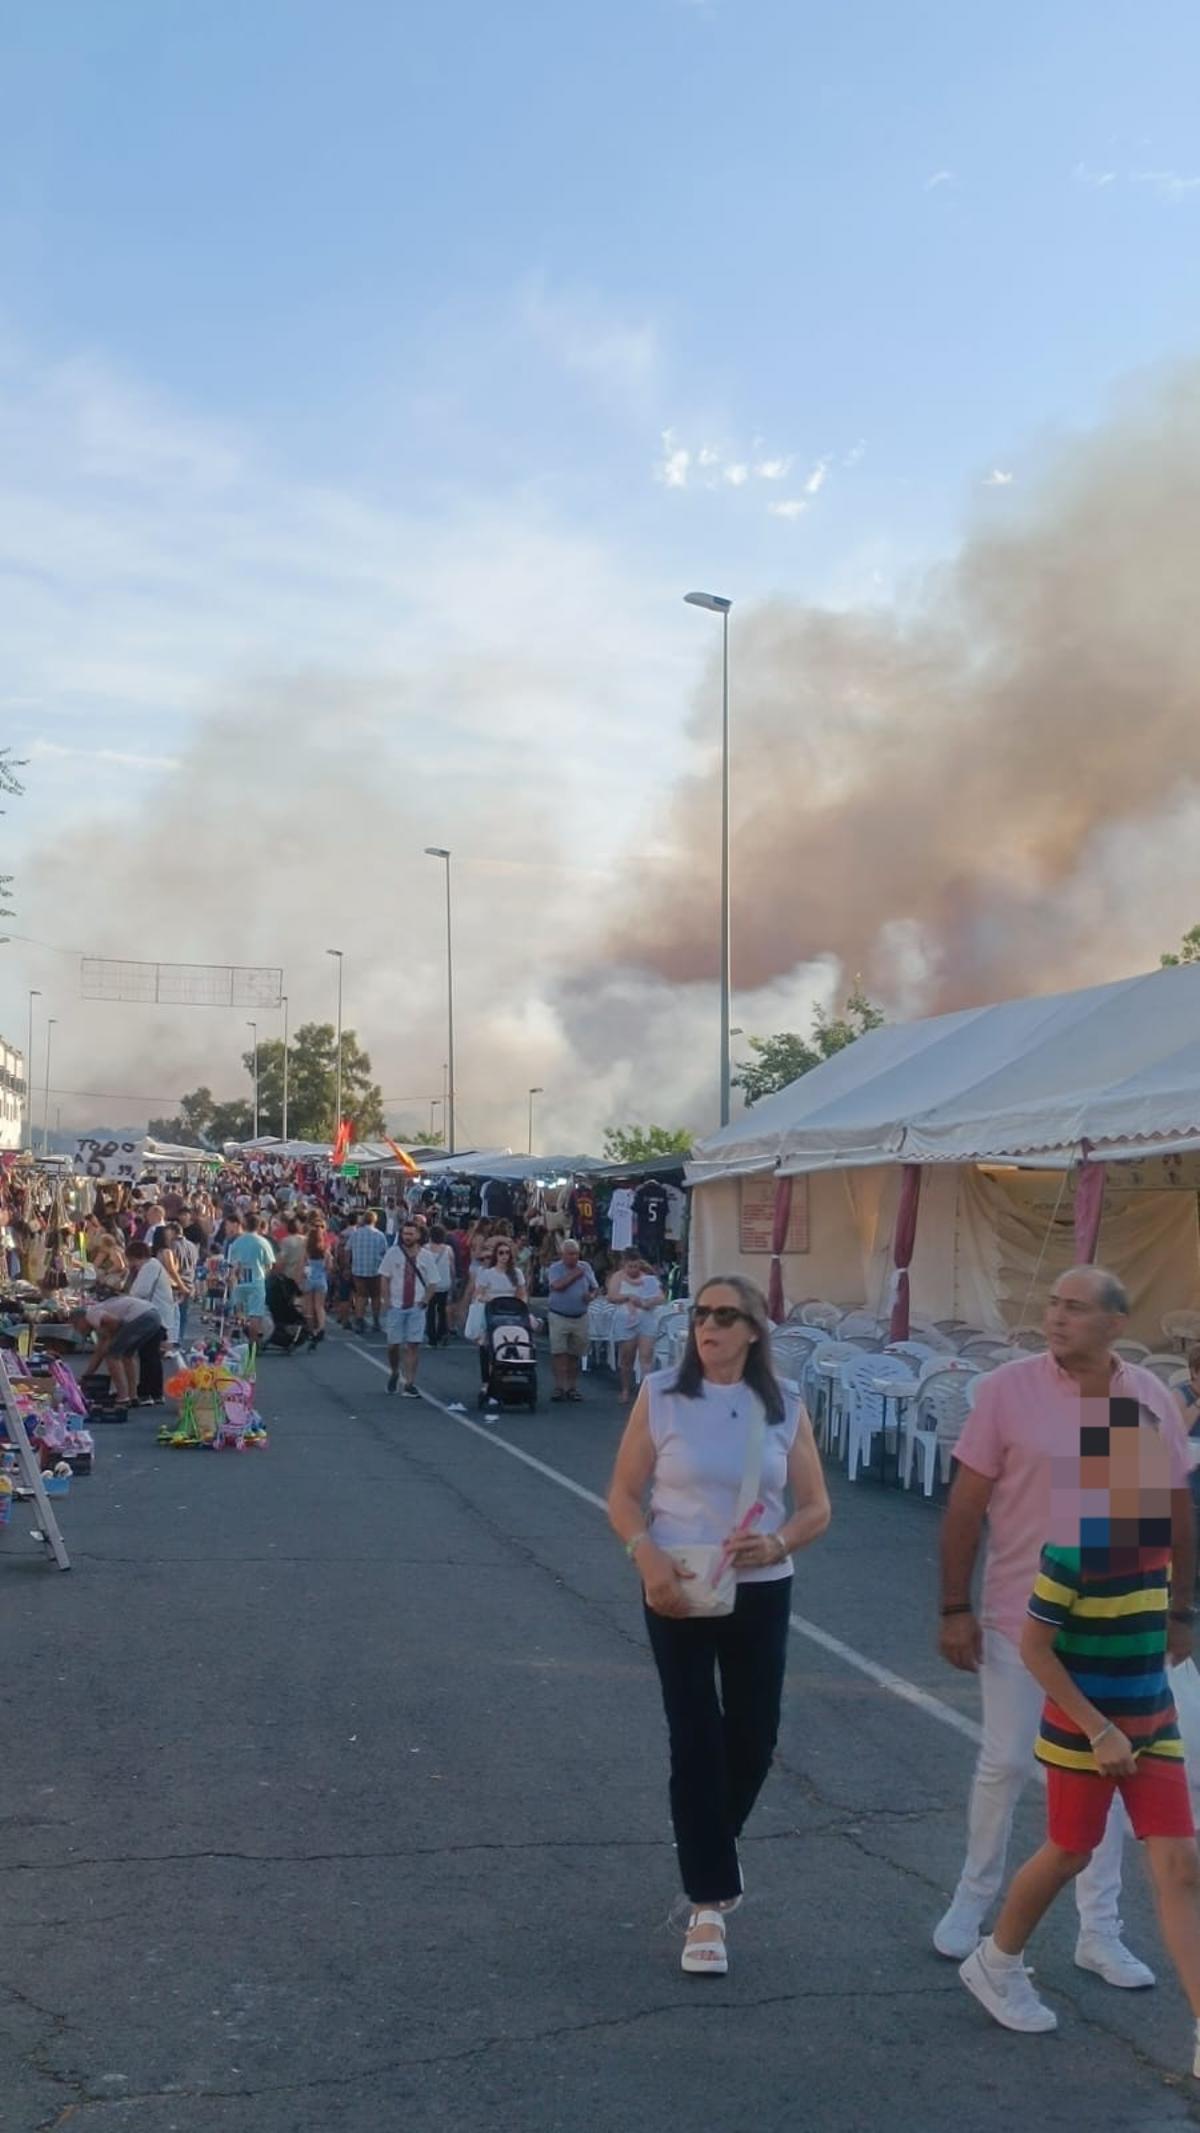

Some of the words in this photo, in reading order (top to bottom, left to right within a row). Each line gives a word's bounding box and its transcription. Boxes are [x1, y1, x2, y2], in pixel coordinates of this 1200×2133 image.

[77, 1139, 135, 1153] TODO
[578, 1201, 593, 1218] 10
[648, 1203, 659, 1222] 5
